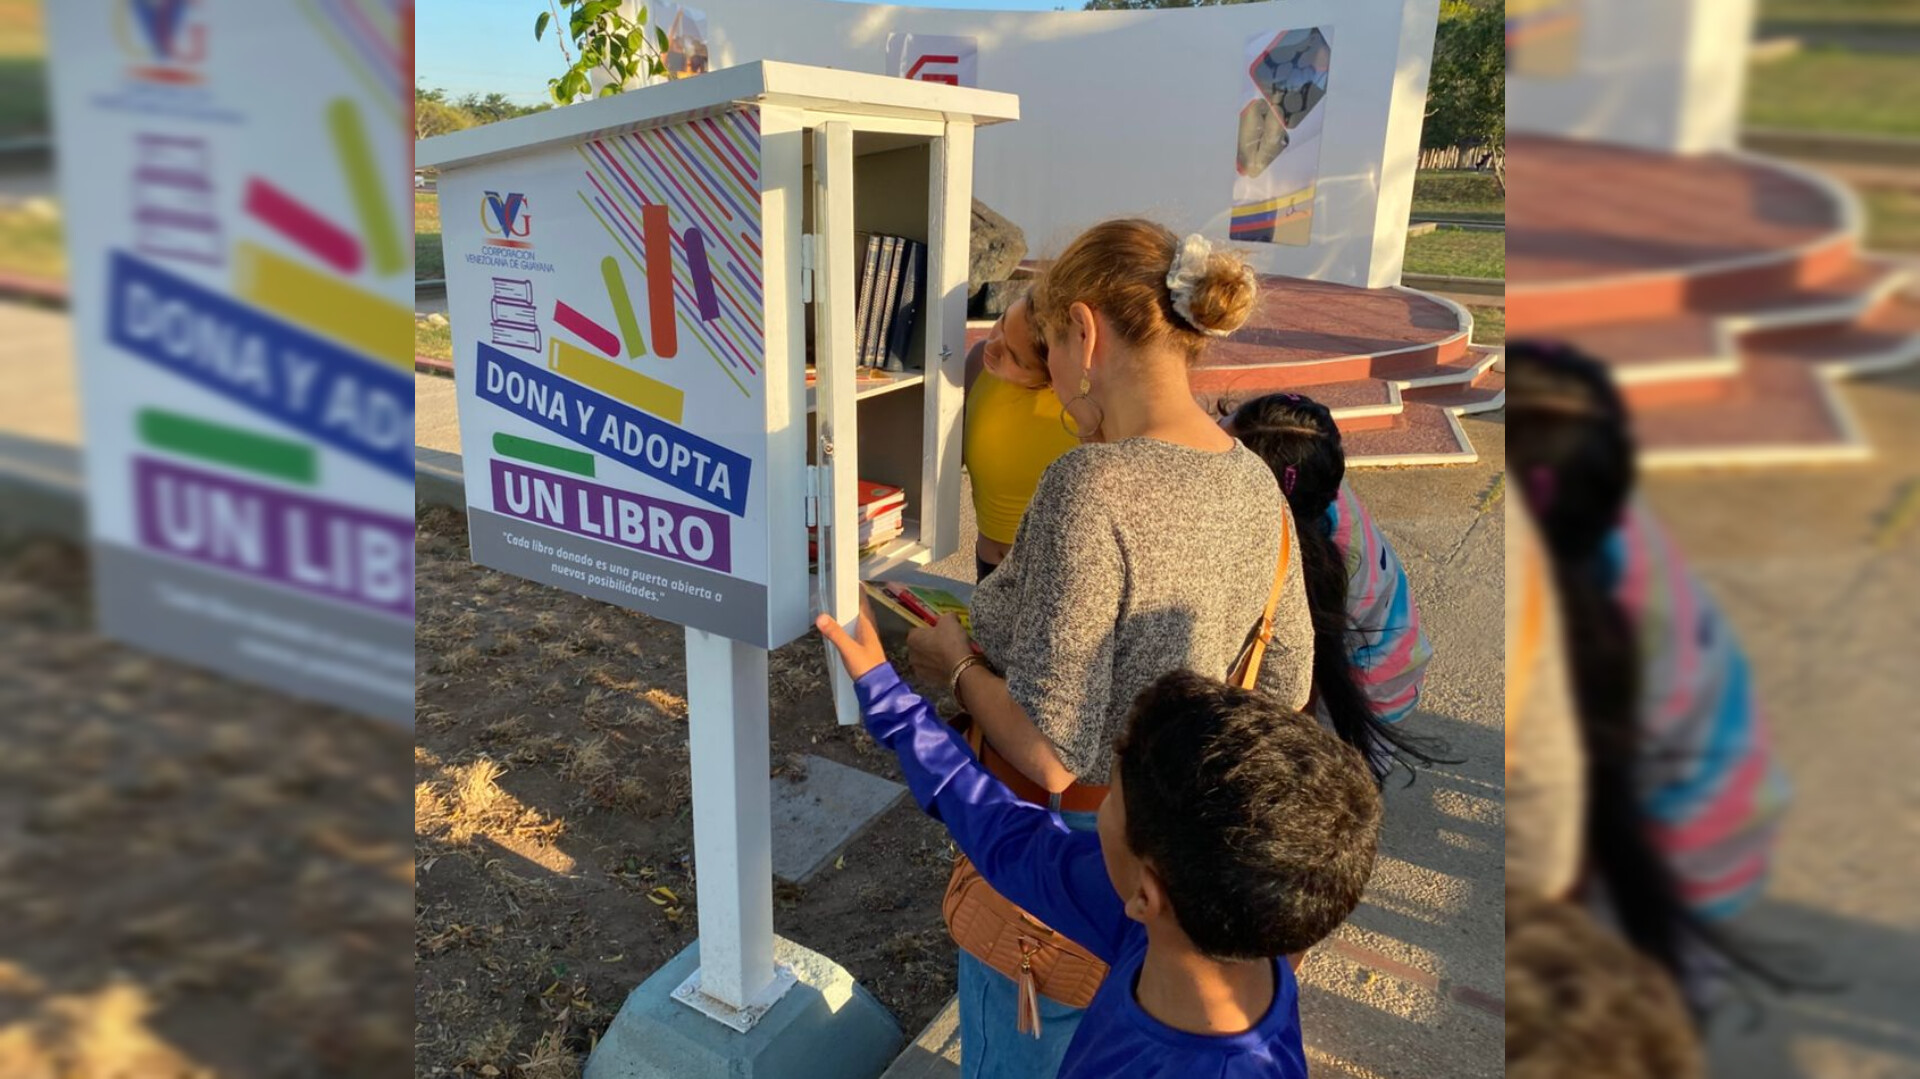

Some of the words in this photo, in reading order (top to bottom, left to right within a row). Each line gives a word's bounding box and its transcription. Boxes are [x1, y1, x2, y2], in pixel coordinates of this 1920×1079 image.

[480, 191, 531, 239] CVG
[465, 253, 508, 268] VENEZOLANA
[509, 258, 519, 270] DE
[520, 260, 556, 273] GUAYANA
[124, 280, 276, 399] DONA
[280, 347, 322, 412] Y
[320, 371, 415, 460] AD
[487, 360, 568, 427] DONA
[576, 399, 596, 436] Y
[598, 413, 732, 500] ADOPTA
[154, 473, 267, 569] UN
[284, 506, 415, 604] LIB
[504, 471, 565, 525] UN
[578, 489, 715, 562] LIBRO
[502, 531, 531, 550] "Cada
[532, 539, 554, 556] libro
[556, 546, 594, 567] donado
[595, 559, 608, 571] es
[609, 563, 630, 577] una
[631, 569, 669, 588] puerta
[670, 578, 713, 600] abierta
[715, 592, 723, 603] a
[551, 562, 587, 581] nuevas
[587, 573, 667, 602] posibilidades."
